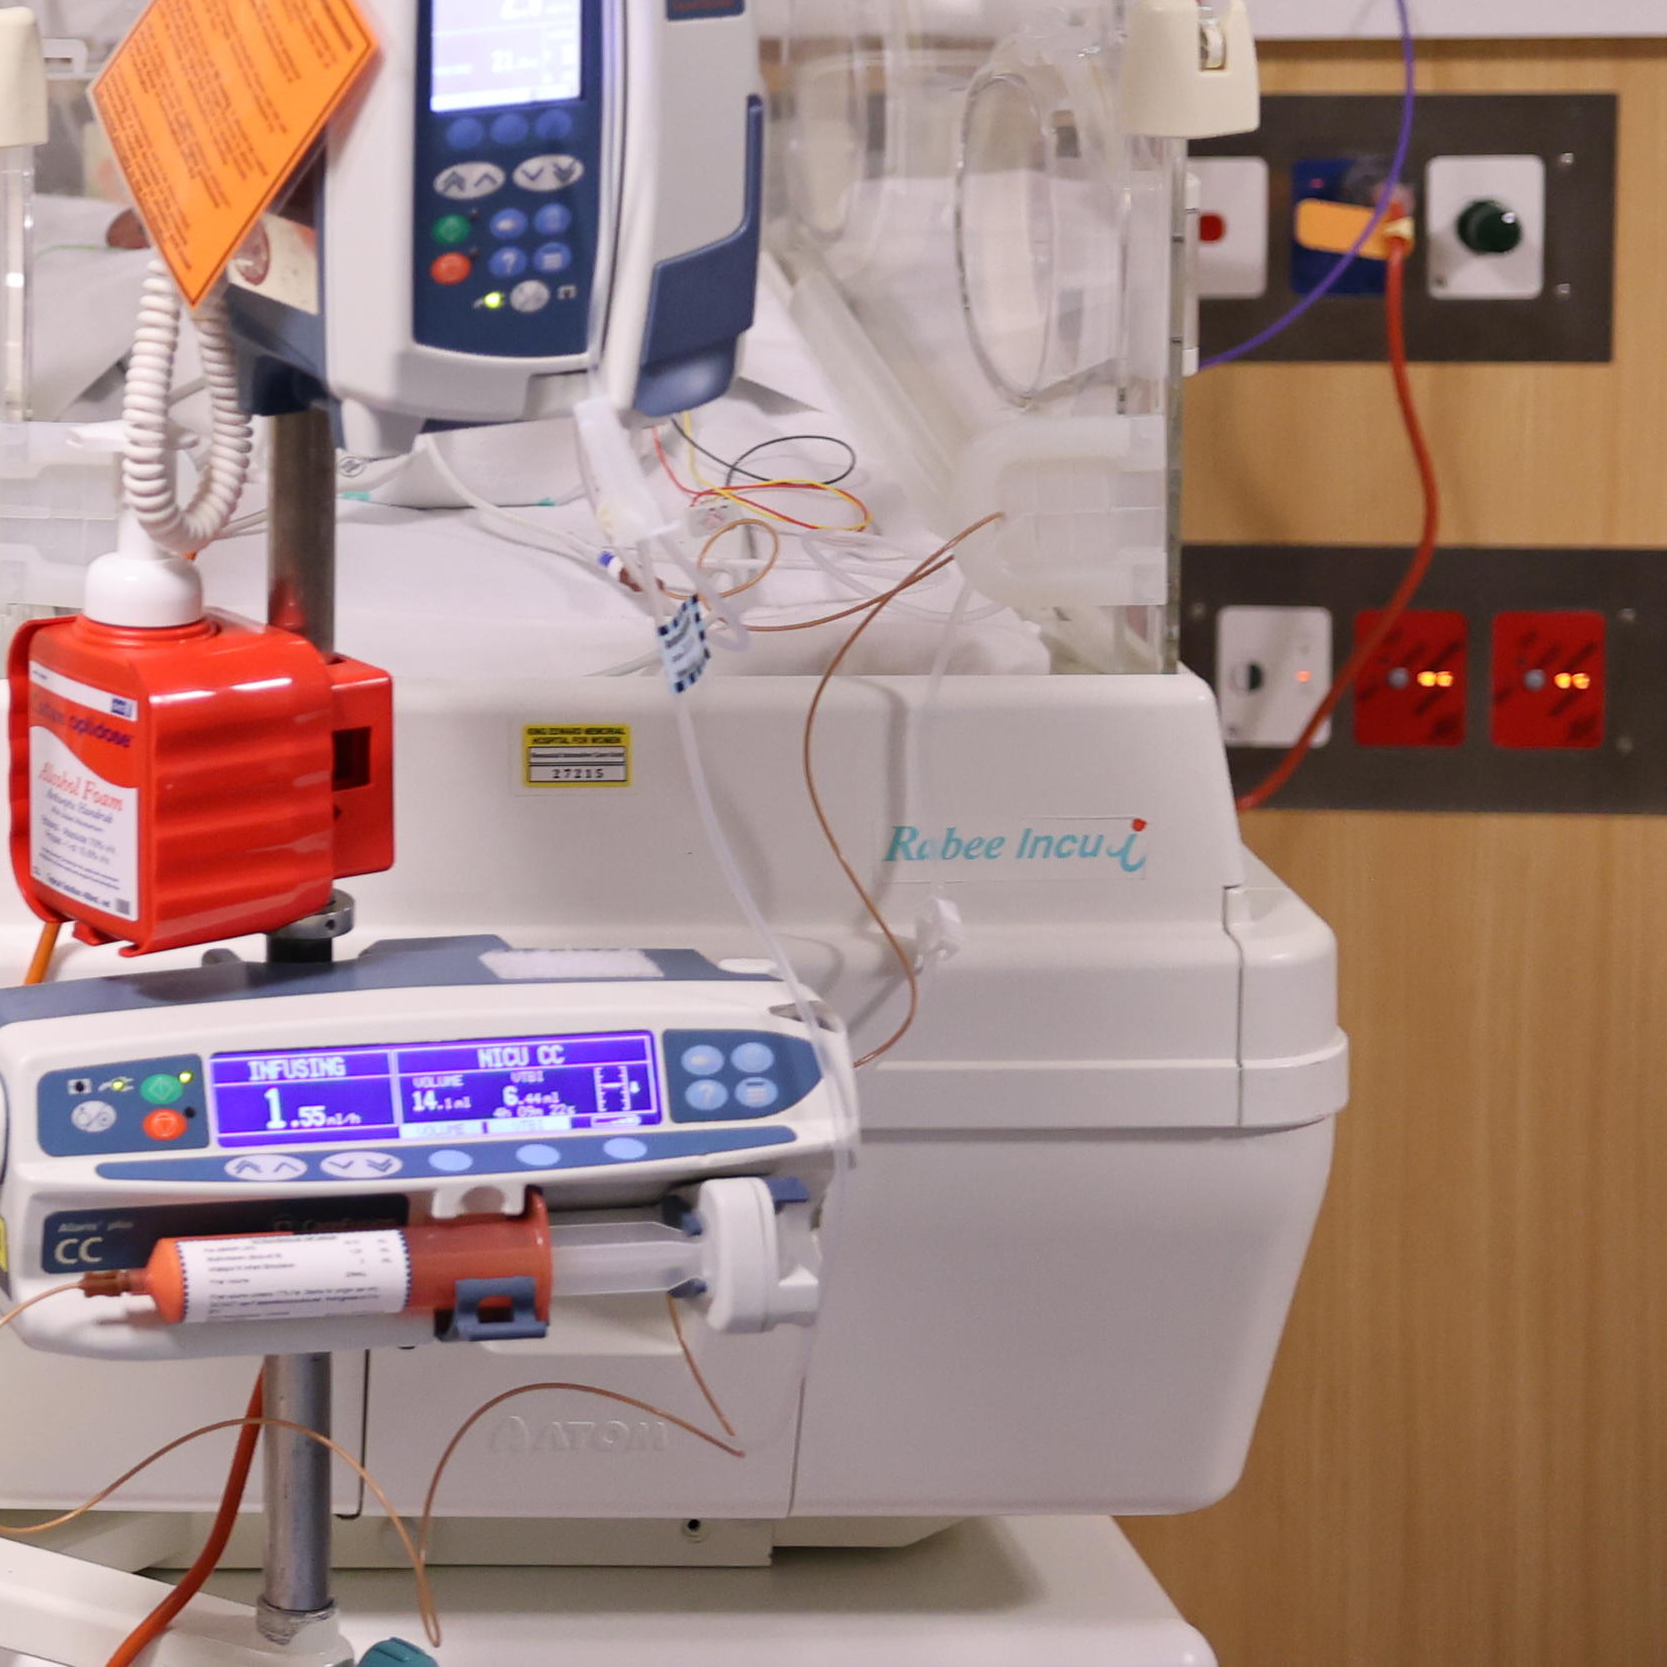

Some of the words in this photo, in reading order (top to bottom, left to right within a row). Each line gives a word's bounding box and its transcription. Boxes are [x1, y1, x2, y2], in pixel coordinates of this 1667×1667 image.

[551, 768, 605, 780] 27215
[38, 762, 79, 797] Alcohol
[82, 780, 124, 812] Foam
[247, 1056, 347, 1081] INFUSING
[477, 1046, 529, 1069] NICU
[537, 1045, 565, 1065] CC
[412, 1075, 465, 1089] VOLUME
[54, 1236, 103, 1265] CC
